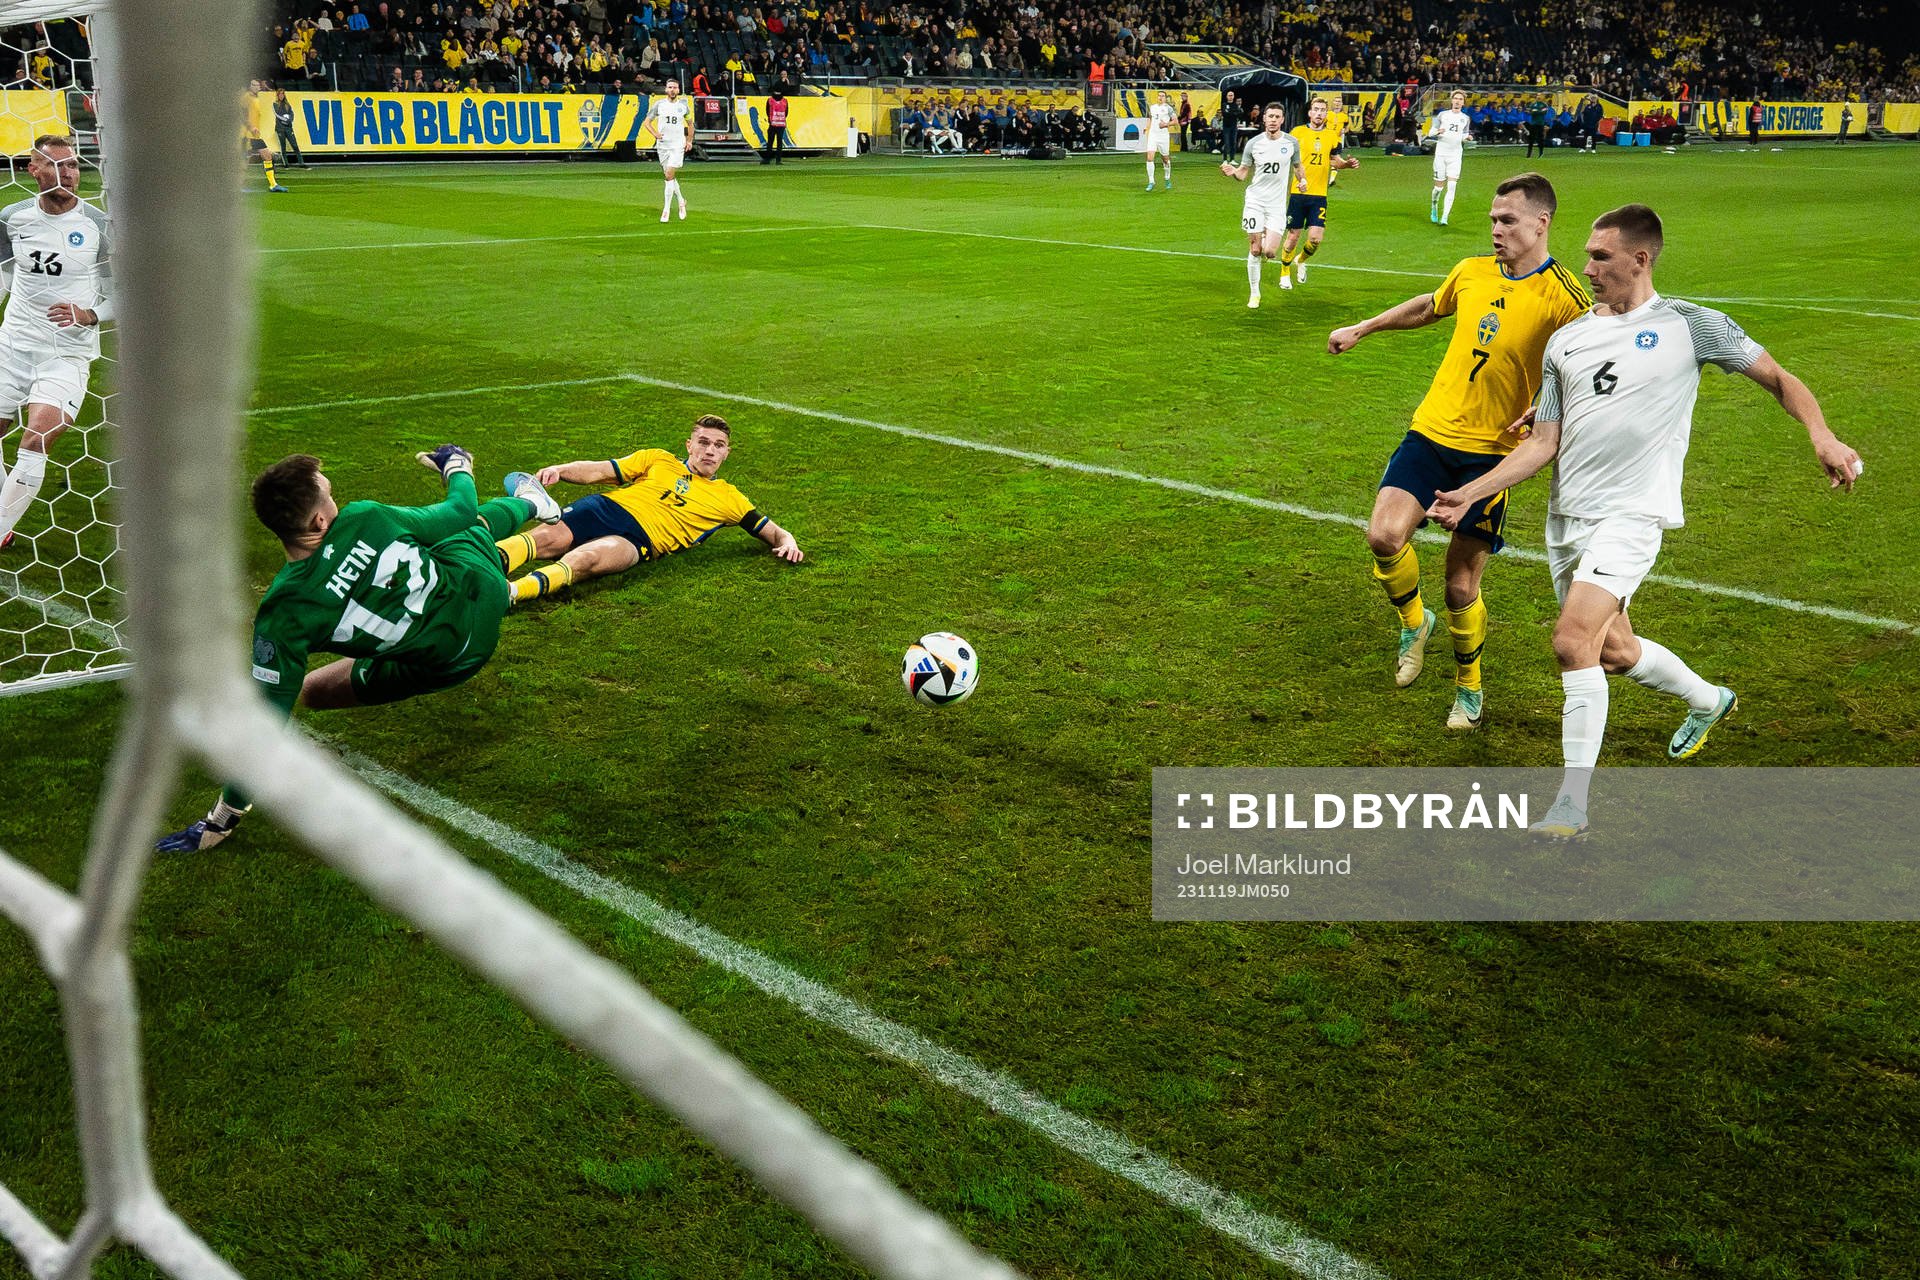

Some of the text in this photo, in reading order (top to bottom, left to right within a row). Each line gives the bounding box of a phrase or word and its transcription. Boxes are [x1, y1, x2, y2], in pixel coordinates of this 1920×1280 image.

[302, 96, 562, 145] VI ÄR BLÅGULT
[665, 115, 678, 125] 18
[1449, 123, 1459, 132] 21
[1777, 105, 1824, 131] SVERIGE
[1263, 162, 1280, 174] 20
[1310, 153, 1322, 165] 21
[29, 250, 63, 276] 16
[1469, 348, 1490, 382] 7
[1593, 361, 1618, 395] 6
[325, 540, 377, 599] HEIN
